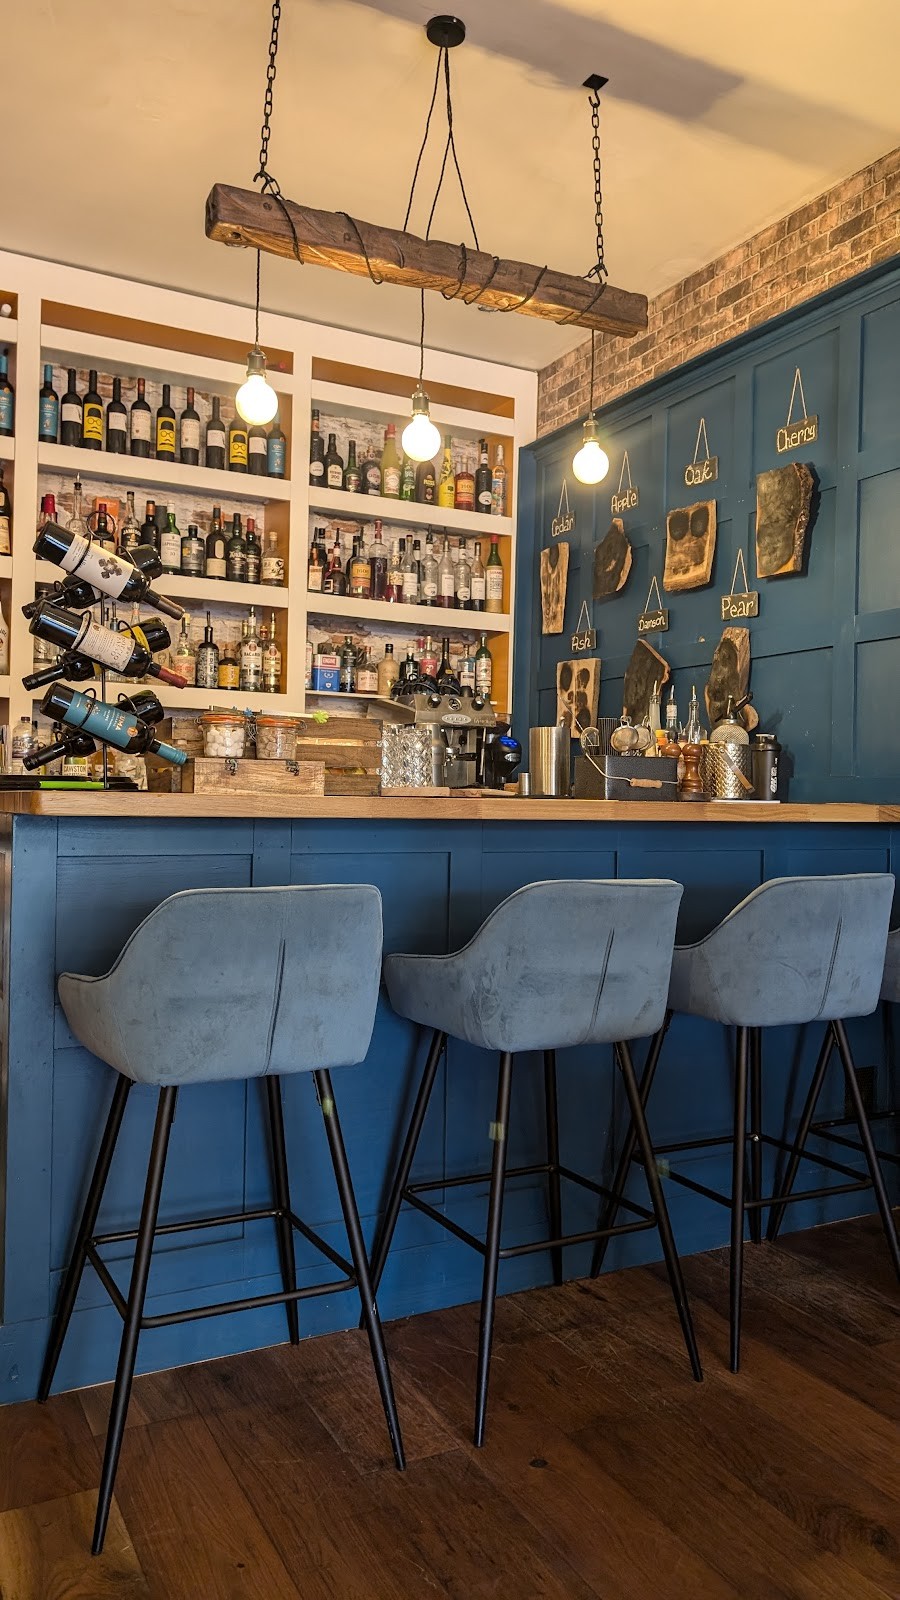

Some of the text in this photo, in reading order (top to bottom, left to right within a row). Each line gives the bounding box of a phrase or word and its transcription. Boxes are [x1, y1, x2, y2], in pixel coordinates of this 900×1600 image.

[778, 425, 816, 453] Cherry
[684, 460, 713, 486] Oak
[611, 489, 637, 513] Apple
[552, 516, 574, 537] Cedar
[721, 596, 755, 619] Pear
[638, 612, 666, 632] Damson
[571, 630, 592, 651] Ash
